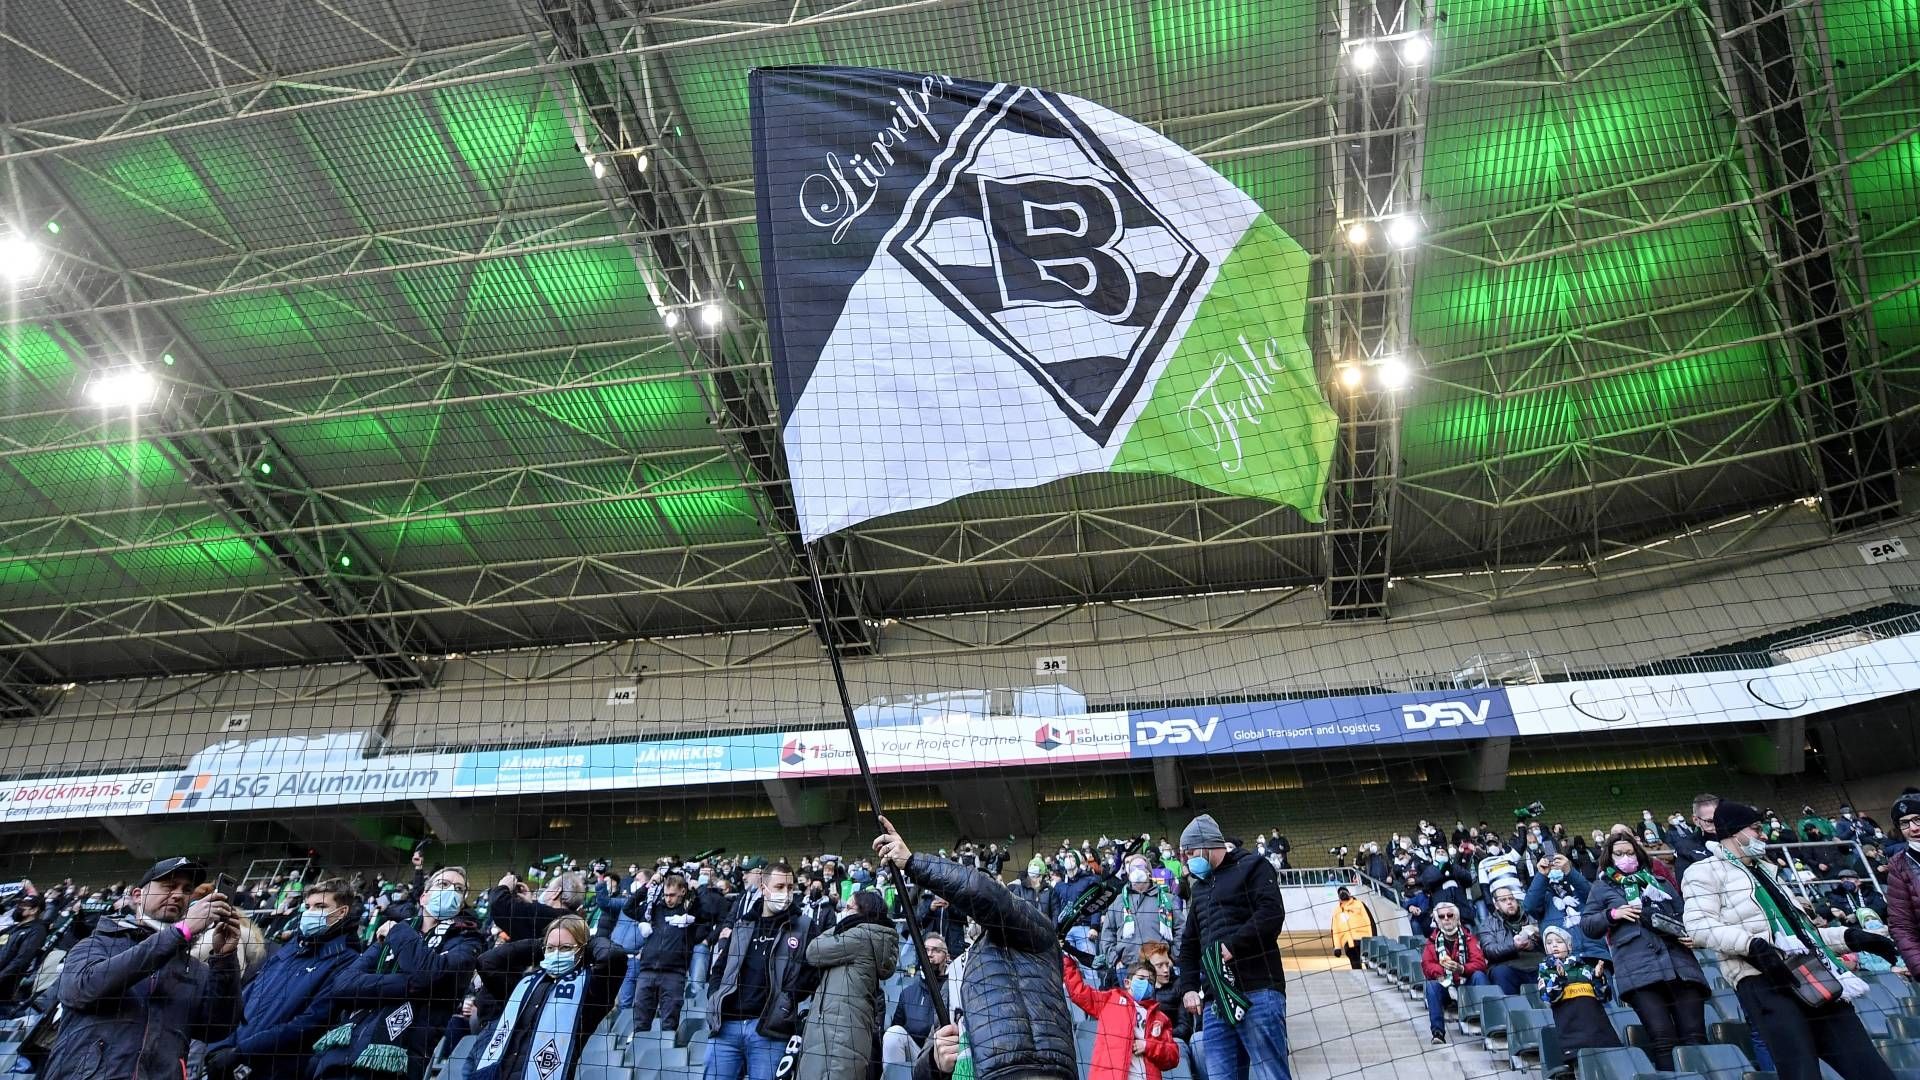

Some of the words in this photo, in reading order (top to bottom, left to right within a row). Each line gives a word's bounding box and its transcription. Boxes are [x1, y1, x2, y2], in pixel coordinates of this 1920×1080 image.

[978, 174, 1138, 322] B
[1402, 699, 1491, 729] DSV
[881, 738, 911, 752] Your
[916, 738, 965, 751] Project
[970, 734, 1023, 746] Partner
[1077, 732, 1130, 744] solution
[1136, 717, 1220, 745] DSV
[1233, 728, 1265, 741] Global
[1266, 726, 1313, 740] Transport
[1316, 725, 1335, 736] and
[1337, 722, 1381, 736] Logistics
[820, 749, 870, 759] soluti
[210, 775, 270, 798] ASG
[278, 767, 440, 795] Aluminium
